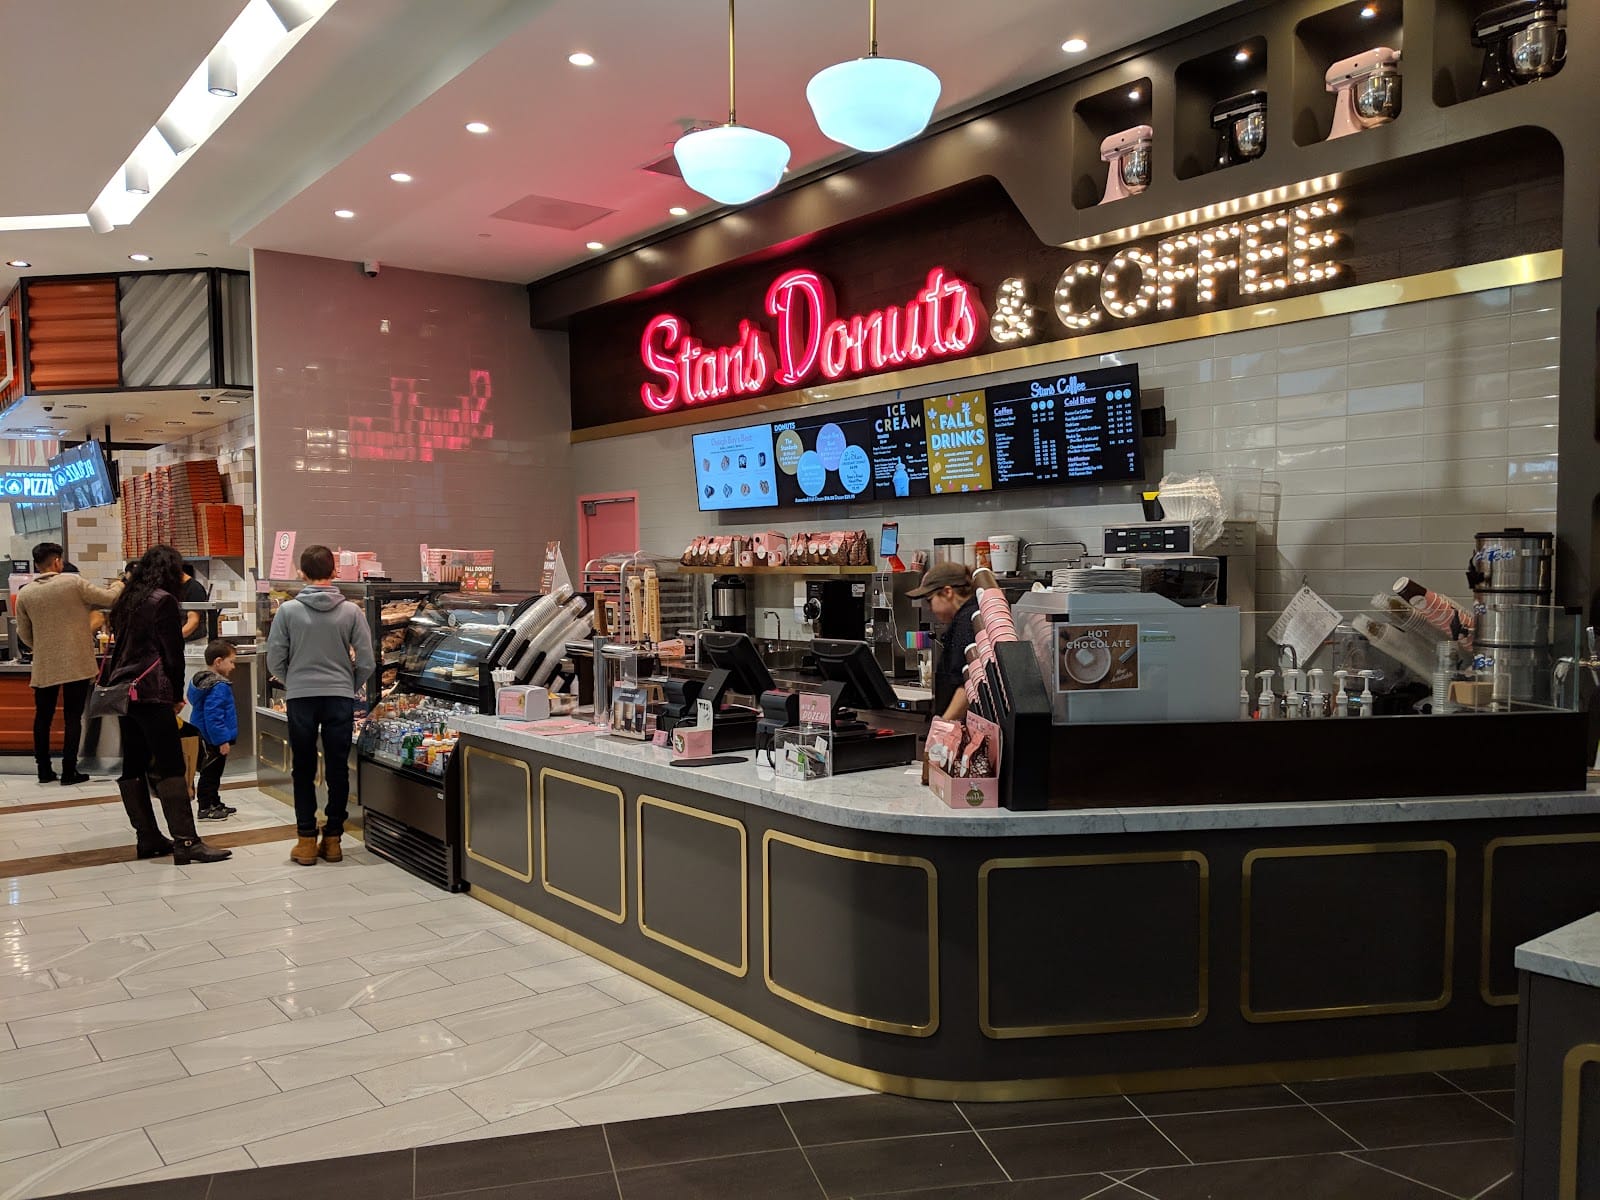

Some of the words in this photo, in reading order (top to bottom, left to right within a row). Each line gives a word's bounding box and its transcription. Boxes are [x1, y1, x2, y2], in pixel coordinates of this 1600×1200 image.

[641, 314, 769, 411] Stan's
[766, 267, 980, 385] Donuts
[990, 277, 1036, 342] &
[1054, 197, 1342, 329] COFFEE
[1056, 375, 1087, 395] Coffee
[887, 403, 907, 417] ICE
[774, 421, 796, 432] DONUTS
[875, 413, 921, 432] CREAM
[939, 411, 974, 430] FALL
[931, 428, 986, 451] DRINKS
[23, 477, 56, 497] PIZZA
[1087, 630, 1110, 639] HOT
[1066, 640, 1131, 649] CHOCOLATE
